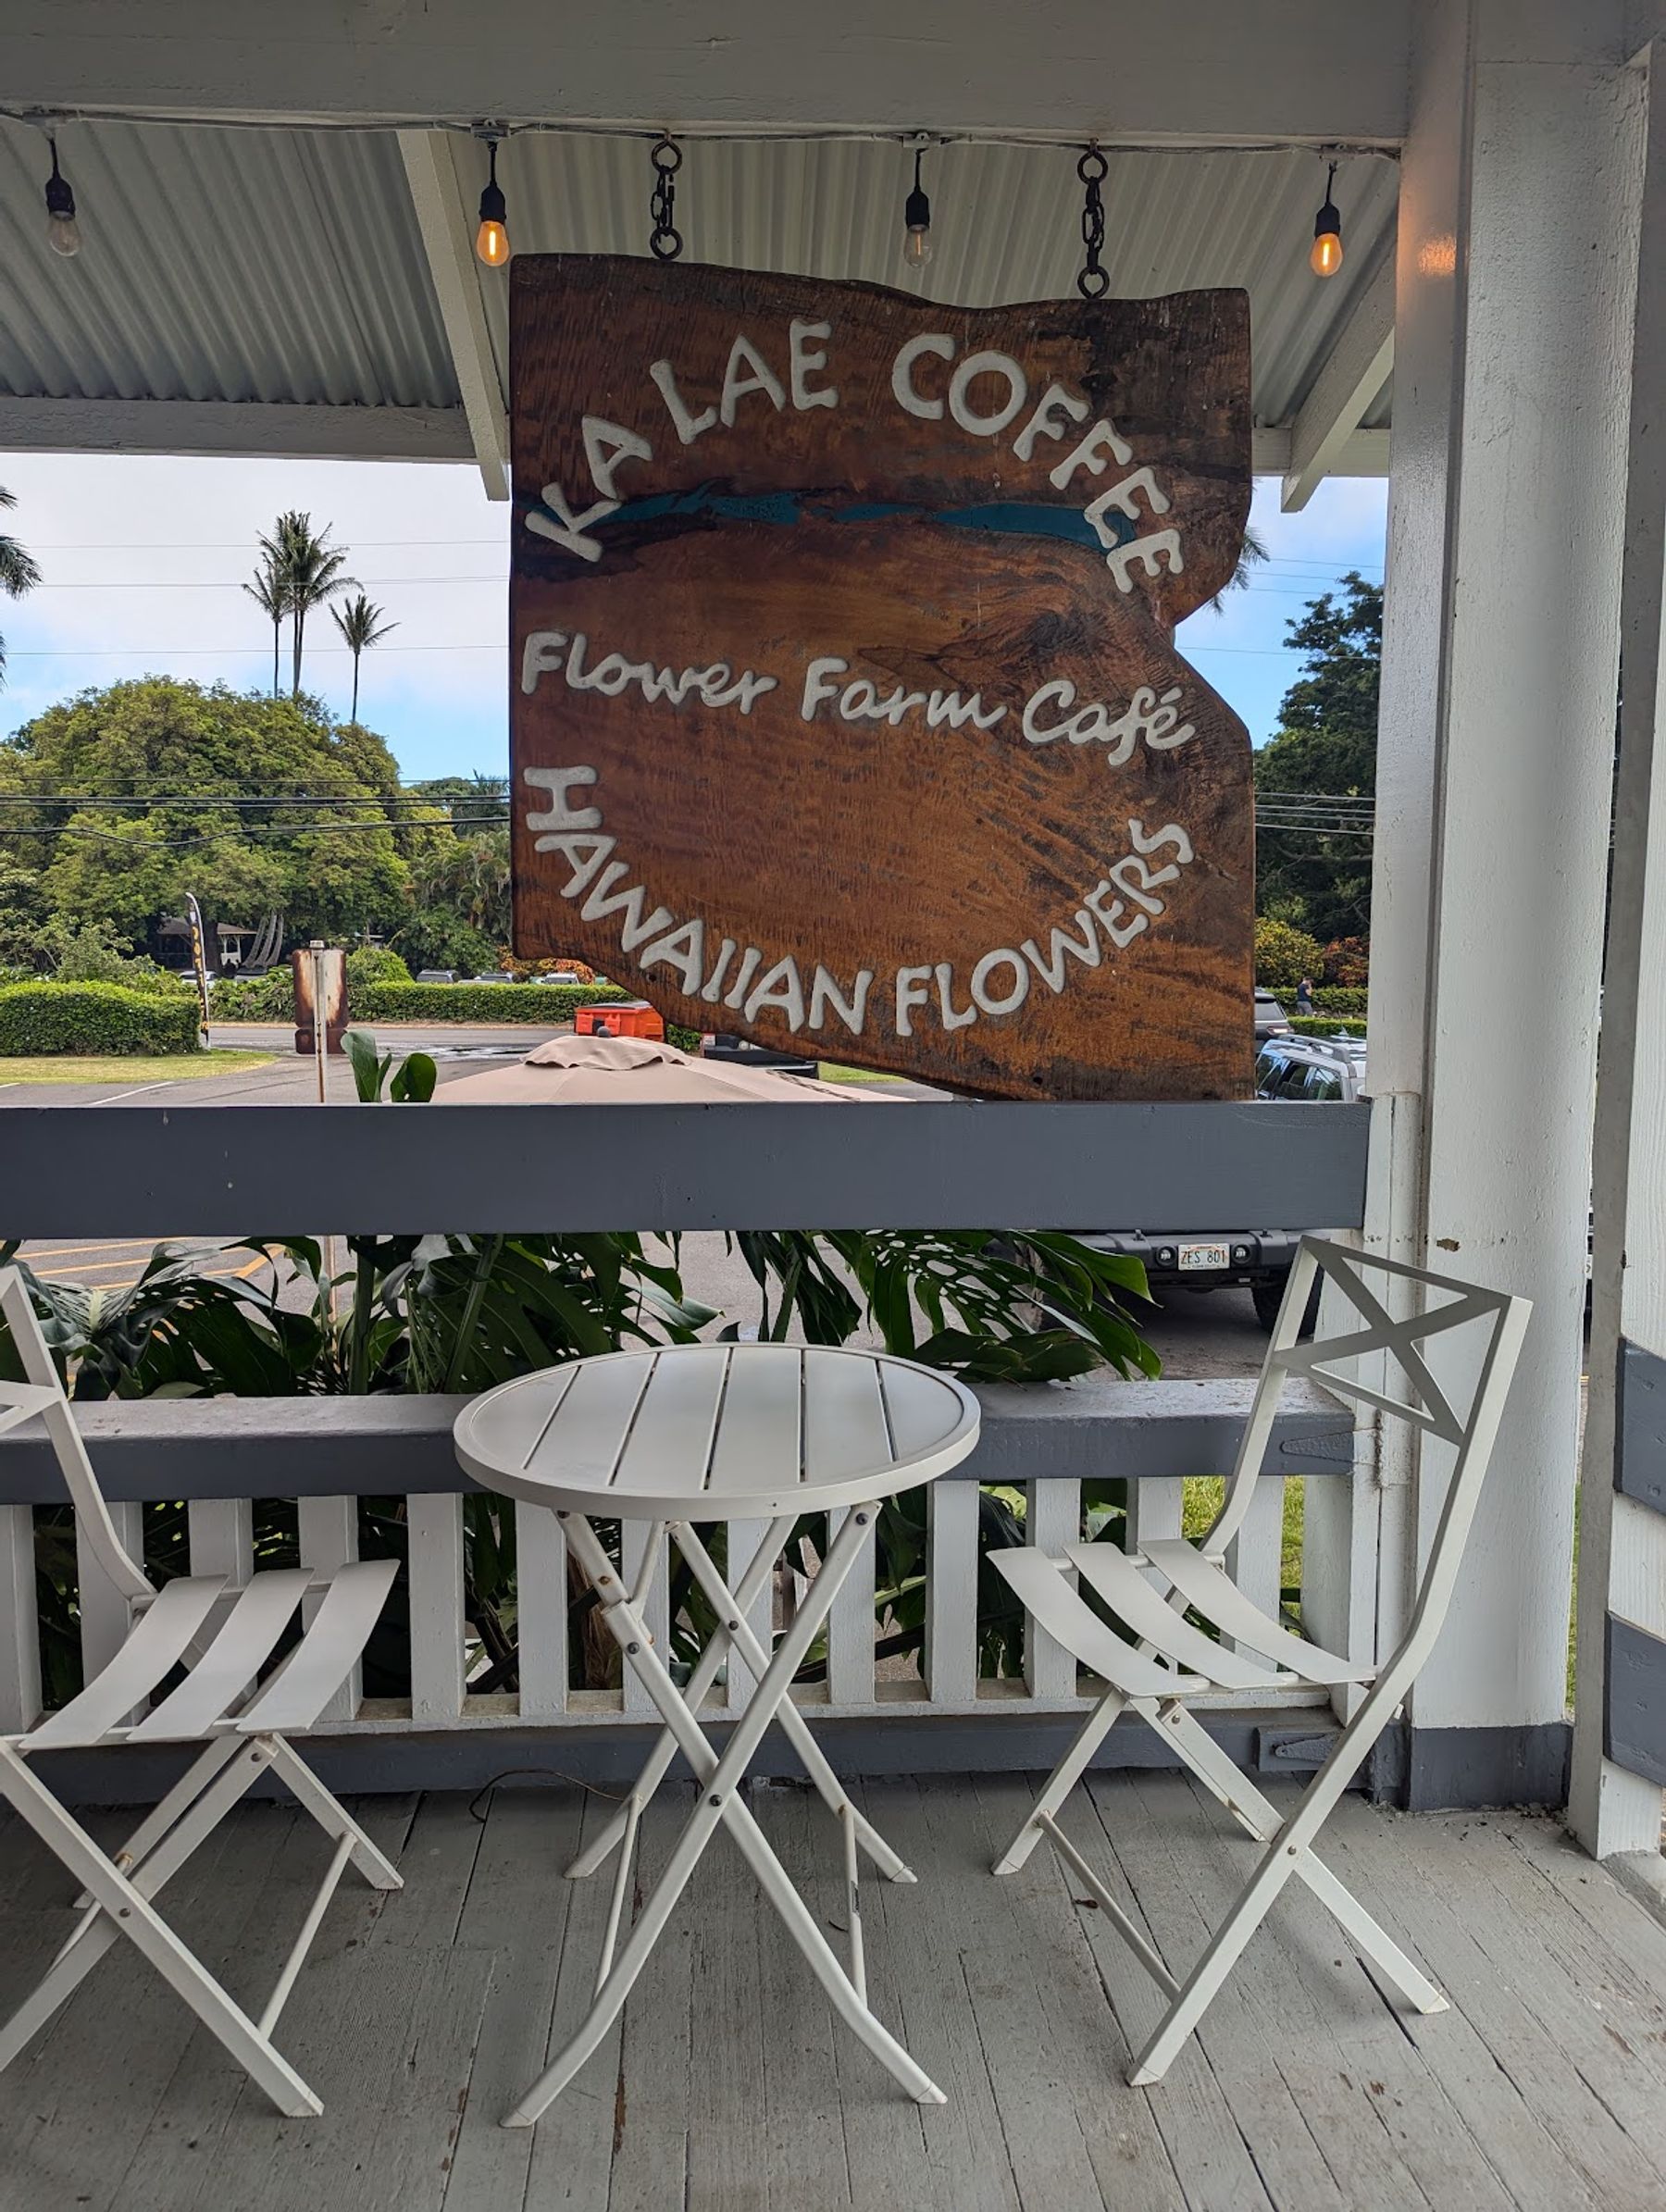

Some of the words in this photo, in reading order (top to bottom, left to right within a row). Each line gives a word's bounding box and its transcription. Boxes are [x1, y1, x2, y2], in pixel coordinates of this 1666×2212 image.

[525, 416, 652, 562] KA
[651, 318, 839, 444] LAE
[892, 333, 1184, 593] COFFEE
[522, 631, 777, 715] Flower
[802, 657, 1007, 729] Farm
[1022, 681, 1195, 766] Café
[524, 764, 874, 1035] HAWAIIAN
[895, 818, 1194, 1036] FLOWERS
[1207, 1249, 1225, 1263] 801
